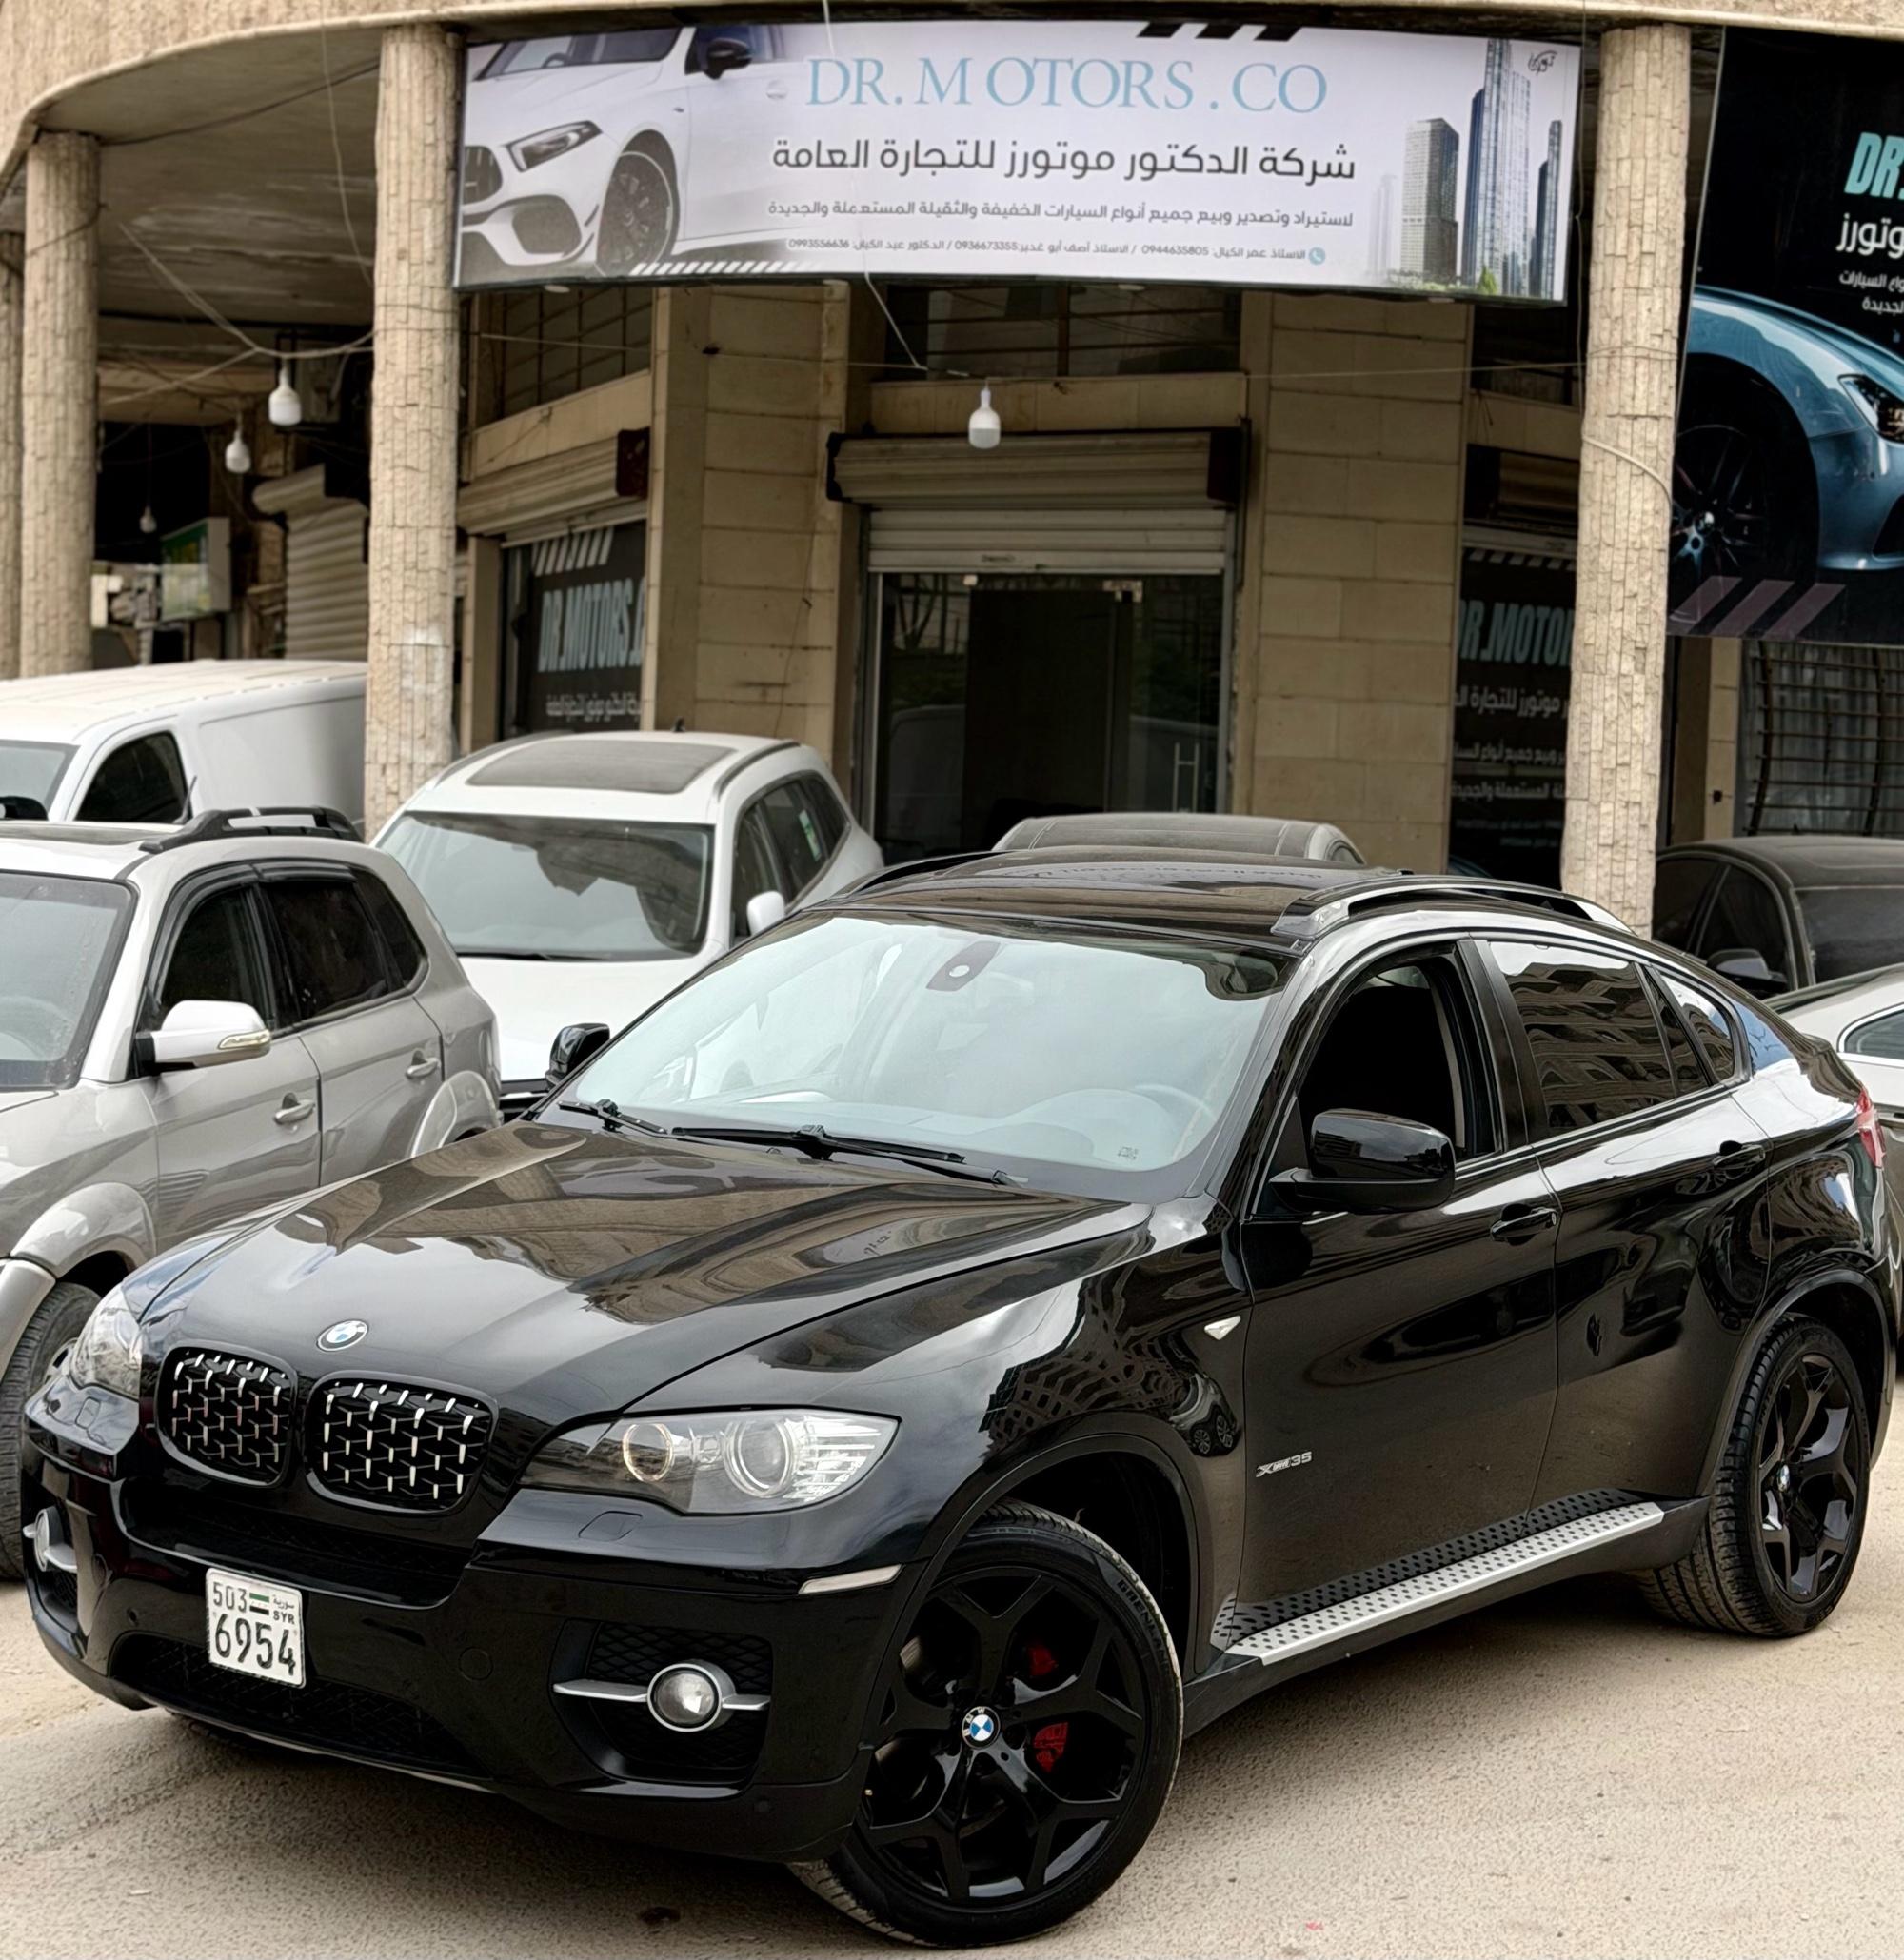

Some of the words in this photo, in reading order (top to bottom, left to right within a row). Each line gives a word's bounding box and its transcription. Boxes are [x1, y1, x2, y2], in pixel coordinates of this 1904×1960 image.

[772, 139, 869, 168] العامة
[880, 139, 995, 177] للتجارة
[1003, 140, 1115, 179] موتورز
[1124, 143, 1248, 181] الدكتور
[1259, 144, 1355, 187] شركة
[768, 201, 828, 218] والجديدة
[919, 198, 978, 219] والثقيلة
[982, 202, 1041, 219] الخفيفة
[1044, 204, 1107, 221] السيارات
[1110, 202, 1145, 223] أنواع
[1148, 208, 1192, 224] جميع
[1197, 208, 1232, 226] وبيع
[1237, 209, 1290, 227] وتصدير
[1293, 210, 1353, 228] لاستيراد
[1141, 245, 1208, 256] 0944635805
[1246, 248, 1266, 259] عمر
[1839, 269, 1888, 289] السيارات
[212, 1581, 248, 1613] 503
[273, 1610, 296, 1625] SYR
[215, 1613, 297, 1676] 6954
